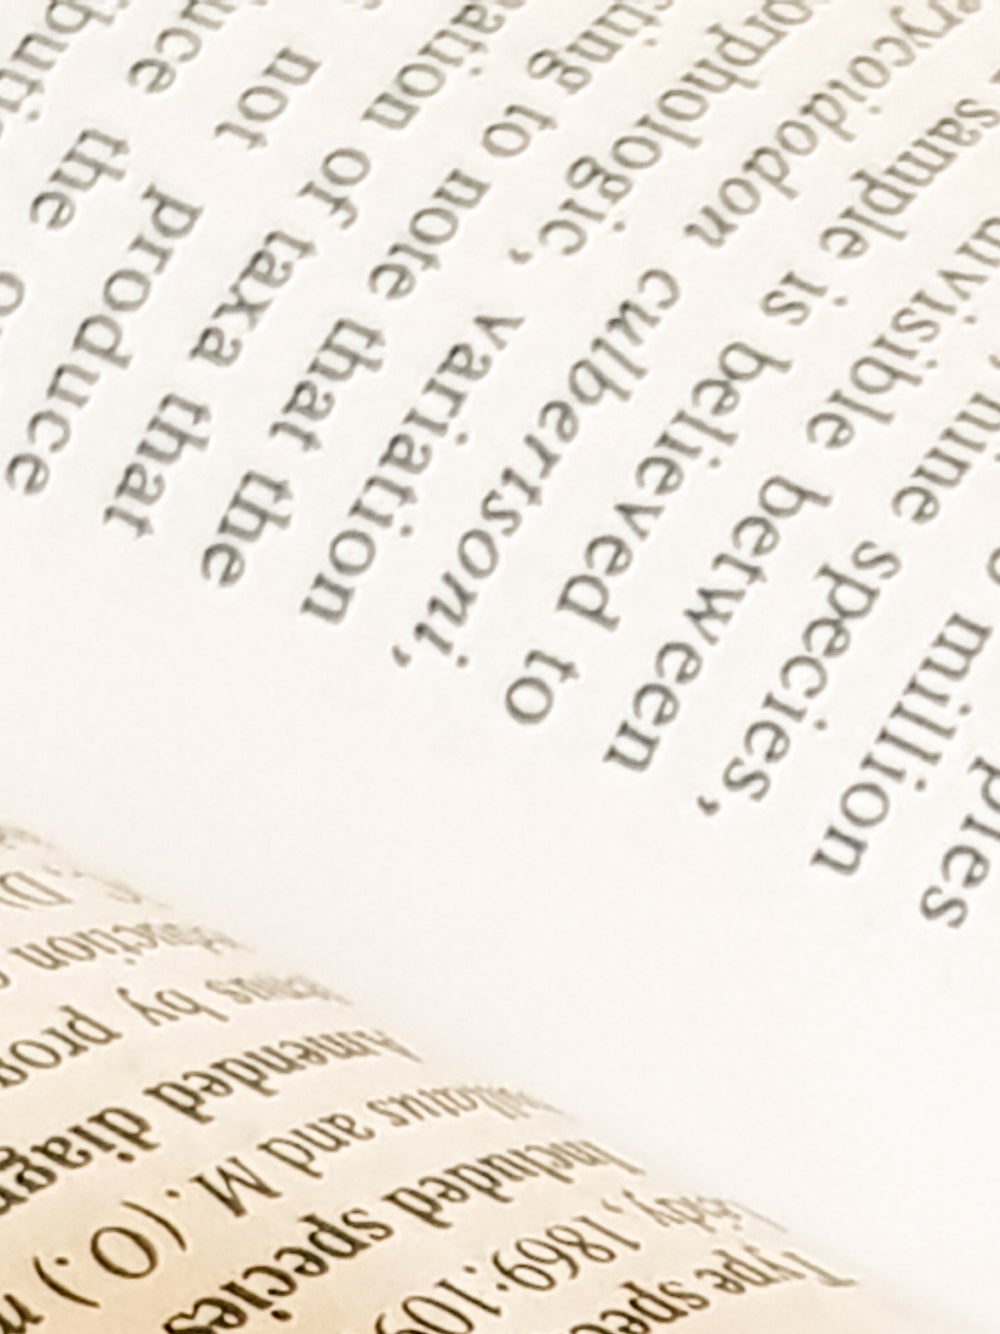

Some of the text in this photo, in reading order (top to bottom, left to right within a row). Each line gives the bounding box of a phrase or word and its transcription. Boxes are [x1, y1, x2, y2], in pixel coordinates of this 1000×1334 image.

[30, 129, 129, 229] the
[297, 148, 370, 229] of
[481, 104, 557, 157] to
[4, 46, 321, 495] not produce
[368, 168, 490, 300] note
[188, 230, 315, 367] taxa
[760, 271, 847, 326] is
[268, 318, 385, 452] that
[103, 393, 211, 538] that
[300, 315, 525, 624] variation
[392, 268, 680, 668] culbertsoni,
[556, 341, 792, 632] believed
[201, 470, 293, 587] the
[603, 475, 832, 772] between
[696, 540, 901, 816] species,
[504, 649, 579, 725] to
[810, 612, 993, 876] million
[116, 986, 231, 1027] by
[142, 1029, 426, 1125] Amended
[256, 1112, 376, 1180] and
[380, 1139, 647, 1230] Included
[32, 1199, 189, 1309] (O.)
[692, 1242, 860, 1295] Type
